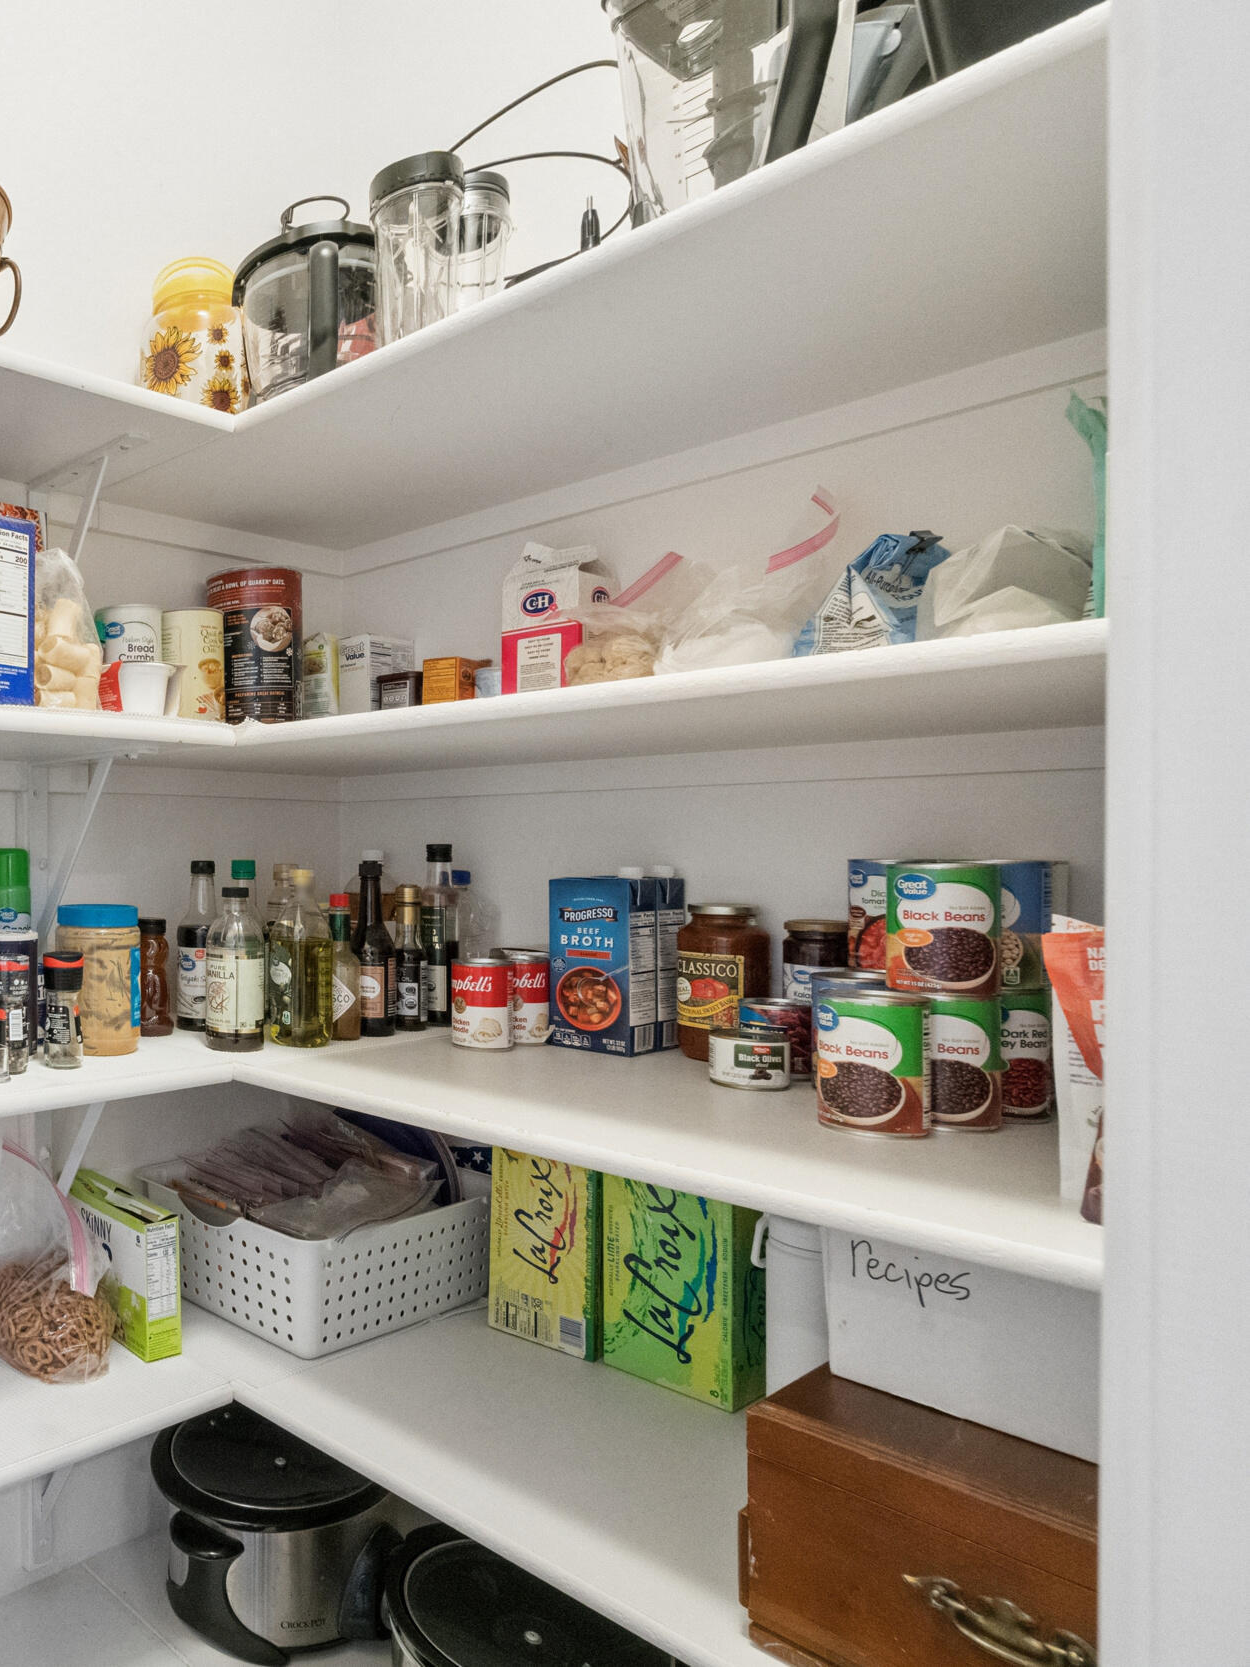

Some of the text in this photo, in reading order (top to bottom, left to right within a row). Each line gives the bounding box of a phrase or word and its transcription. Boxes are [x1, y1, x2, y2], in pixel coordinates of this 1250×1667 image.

[10, 531, 28, 542] Facts
[15, 556, 28, 565] 200
[524, 593, 551, 611] C&H
[127, 643, 155, 653] Bread
[118, 653, 155, 662] Crumbs
[896, 879, 928, 890] Great
[870, 889, 887, 898] Dic
[903, 886, 928, 895] Value
[564, 907, 614, 923] PROGRESSO
[902, 909, 986, 922] Black Beans
[576, 926, 600, 935] BEEF
[559, 934, 614, 949] BROTH
[210, 963, 228, 971] PURE
[677, 958, 738, 978] CLASSICO
[206, 970, 235, 980] ANILLA
[1001, 1028, 1030, 1040] Dark
[936, 1042, 980, 1056] Beans
[1019, 1038, 1048, 1050] Beans
[737, 1053, 783, 1063] Black Olives
[845, 1045, 890, 1060] Beans
[606, 1235, 615, 1262] LIME
[850, 1239, 971, 1308] recipes
